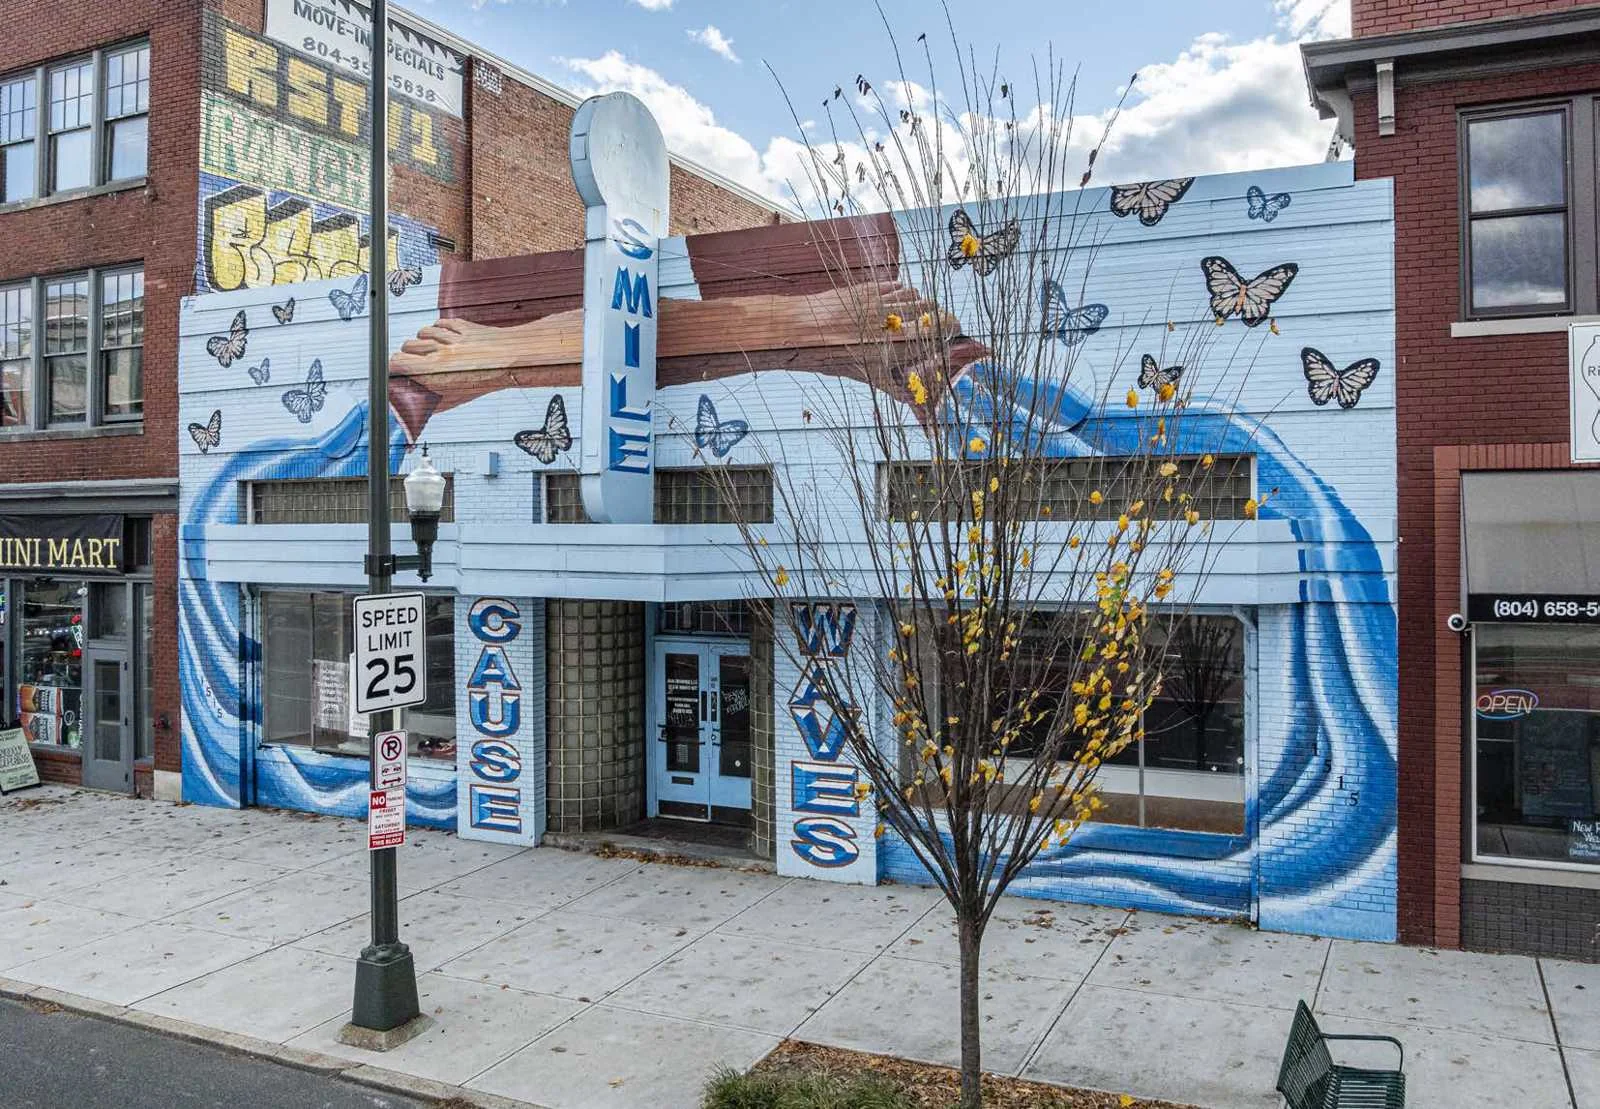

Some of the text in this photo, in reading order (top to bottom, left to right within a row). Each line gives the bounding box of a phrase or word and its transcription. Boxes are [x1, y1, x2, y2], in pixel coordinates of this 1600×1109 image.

[293, 0, 370, 48] MOVE-IN
[387, 40, 445, 81] PECIALS
[302, 36, 436, 102] 804-35-5638
[611, 218, 654, 474] SMILE
[0, 537, 120, 568] INI MART
[362, 607, 418, 628] SPEED
[1494, 599, 1600, 618] (804) 658-5
[368, 631, 413, 652] LIMIT
[366, 654, 416, 700] 25
[467, 597, 522, 834] CAUSE
[1477, 695, 1533, 714] OPEN
[787, 602, 862, 868] WAVES
[372, 796, 386, 806] NO
